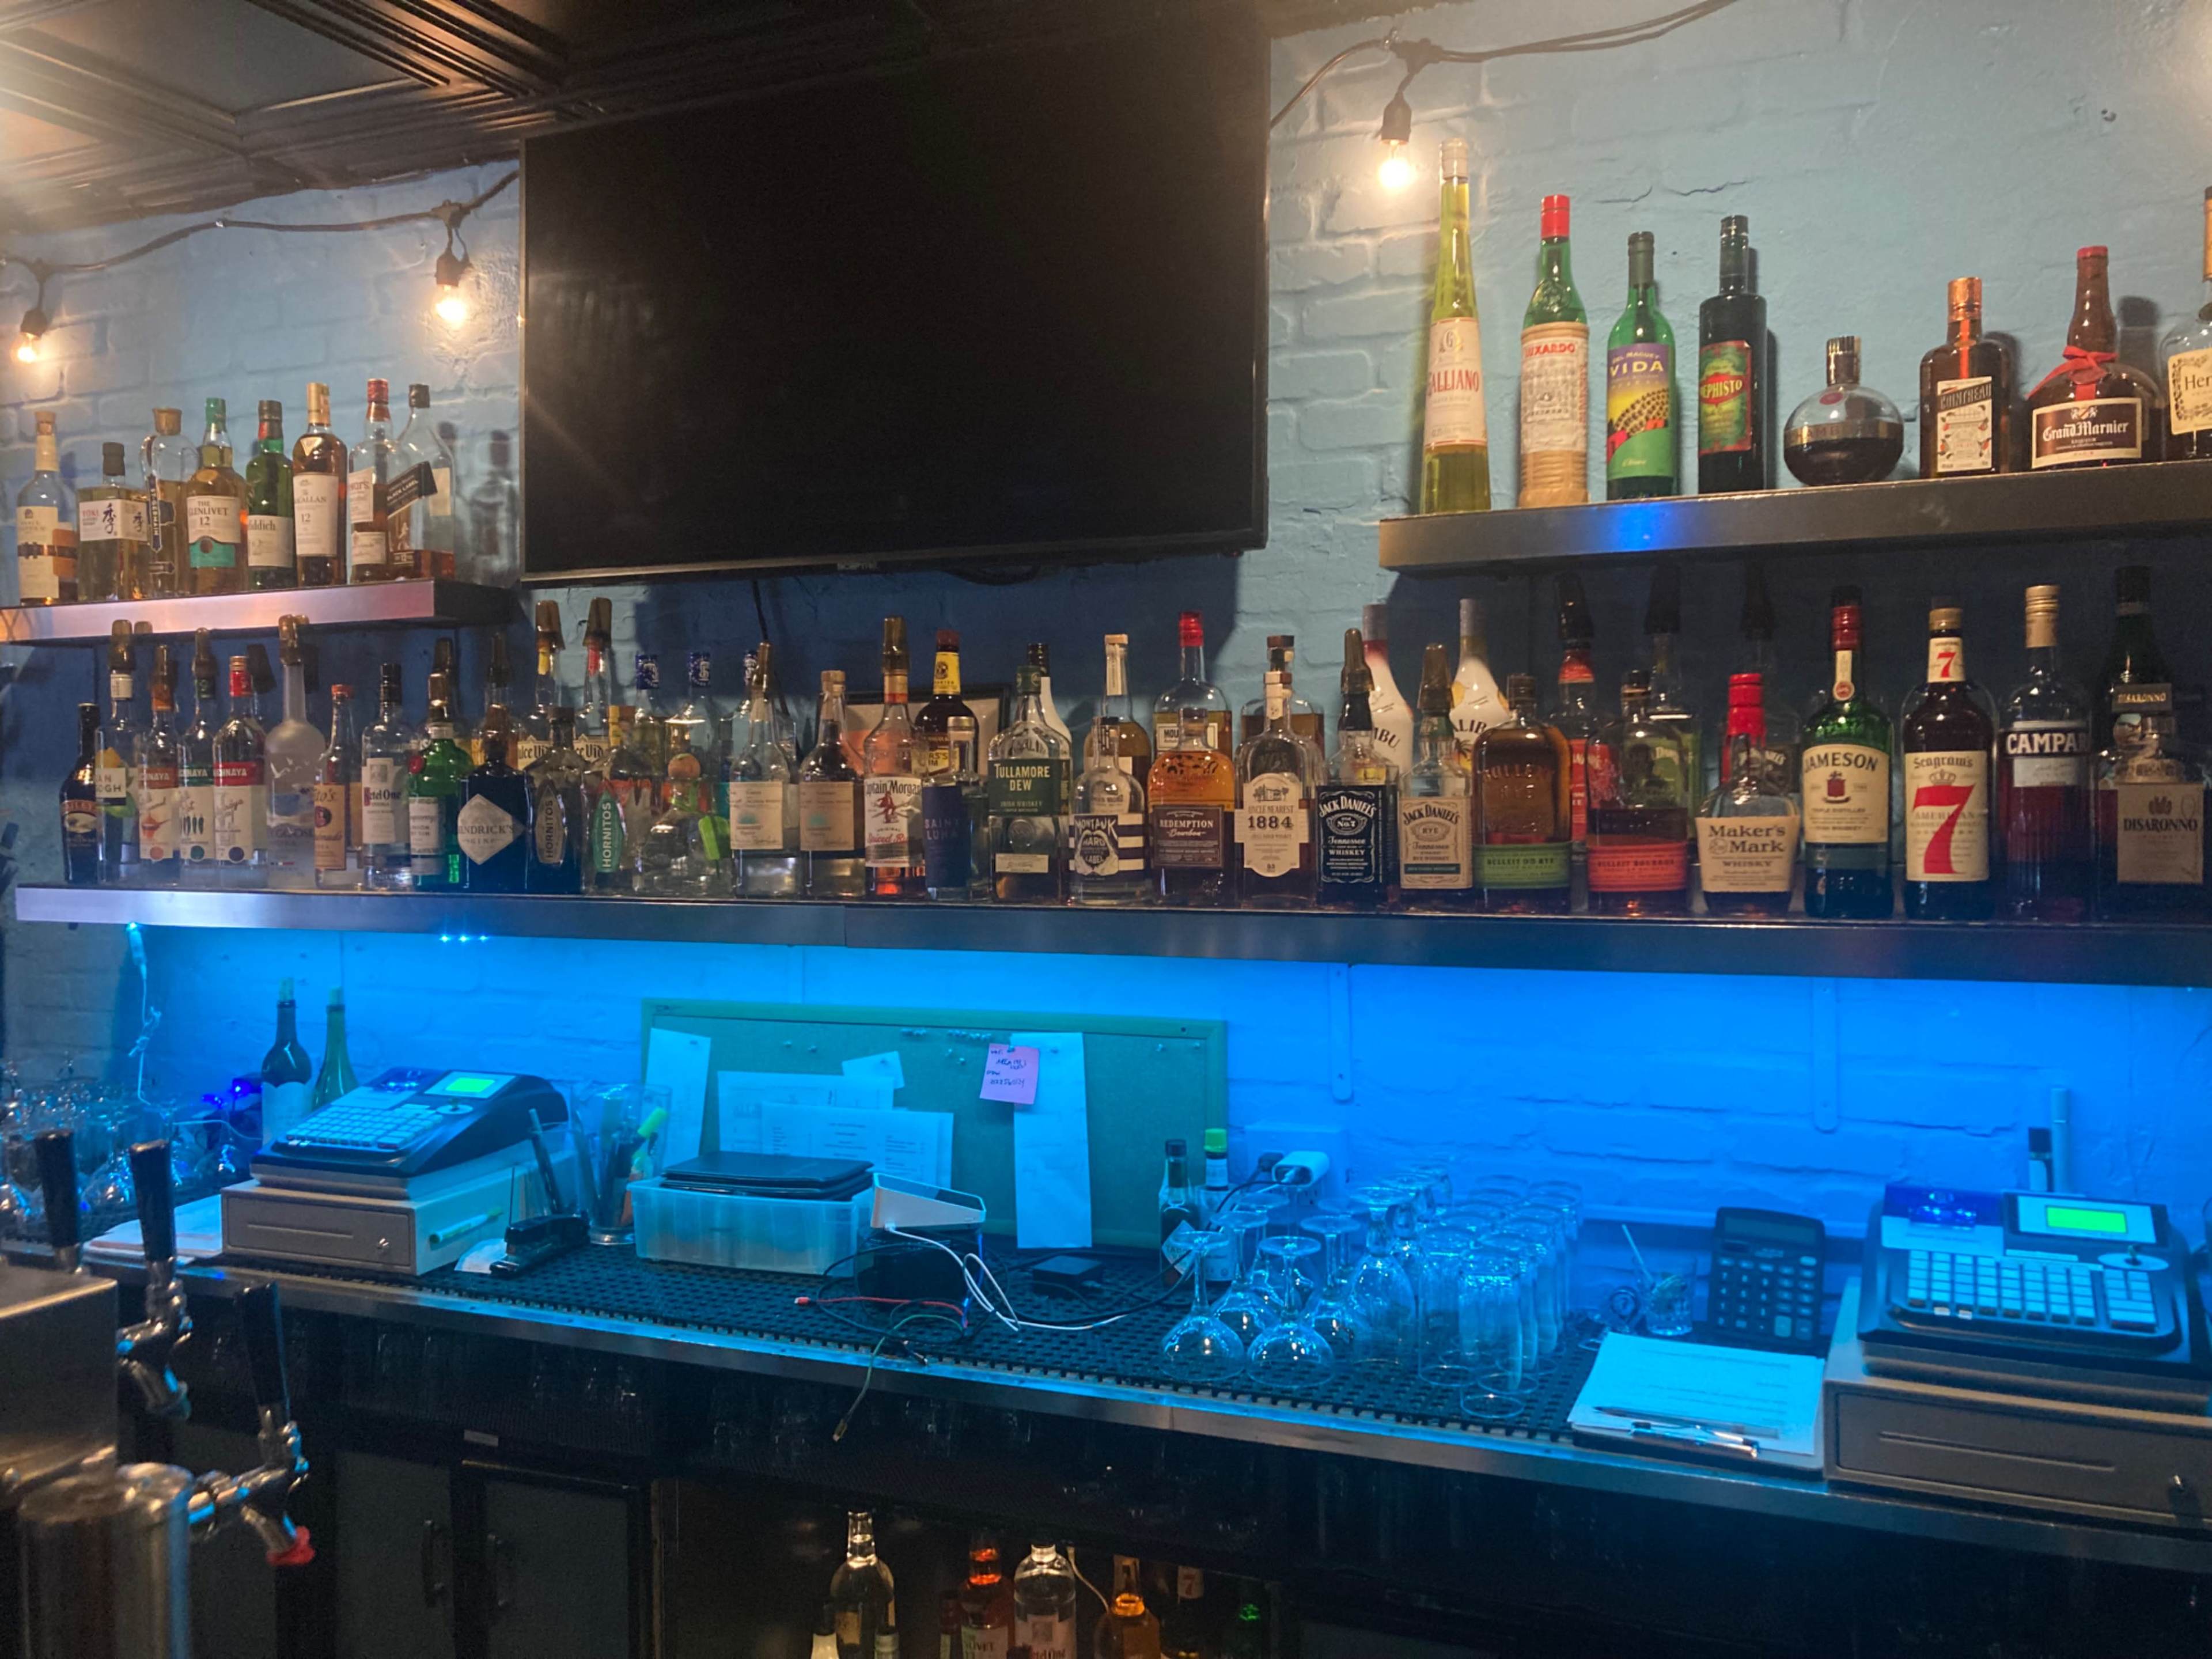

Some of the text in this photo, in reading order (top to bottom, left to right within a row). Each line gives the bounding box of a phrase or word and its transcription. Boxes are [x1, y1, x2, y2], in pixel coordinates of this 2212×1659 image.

[1610, 361, 1664, 377] VIDA
[1428, 369, 1480, 397] ALLIANO
[1940, 382, 1992, 410] COINTREAU
[2042, 419, 2129, 442] Grand Marnier
[102, 502, 117, 535] 季
[199, 517, 211, 526] 12
[301, 513, 311, 523] 12
[1936, 651, 1957, 678] 7
[1804, 751, 1878, 774] JAMESON
[1912, 756, 1974, 770] Seagram's
[994, 763, 1051, 779] TULLAMORE
[1009, 779, 1032, 791] DEW
[1267, 805, 1294, 813] NEAREST
[1319, 796, 1377, 819] JACK DANIEL'S
[1403, 804, 1460, 826] JACK DANIEL'S
[1915, 811, 1976, 819] AMERIAN
[546, 800, 554, 858] HORNITOS
[1074, 819, 1119, 842] MONTAUK
[1159, 819, 1214, 828] REDEMPTION
[1247, 815, 1295, 830] 1884
[1912, 783, 1976, 875] 7
[2123, 817, 2198, 833] DISARONNO
[602, 802, 612, 868] HORNITOS
[1707, 824, 1786, 838] Maker's
[1327, 836, 1366, 845] Tennessee
[1729, 839, 1786, 854] Mark
